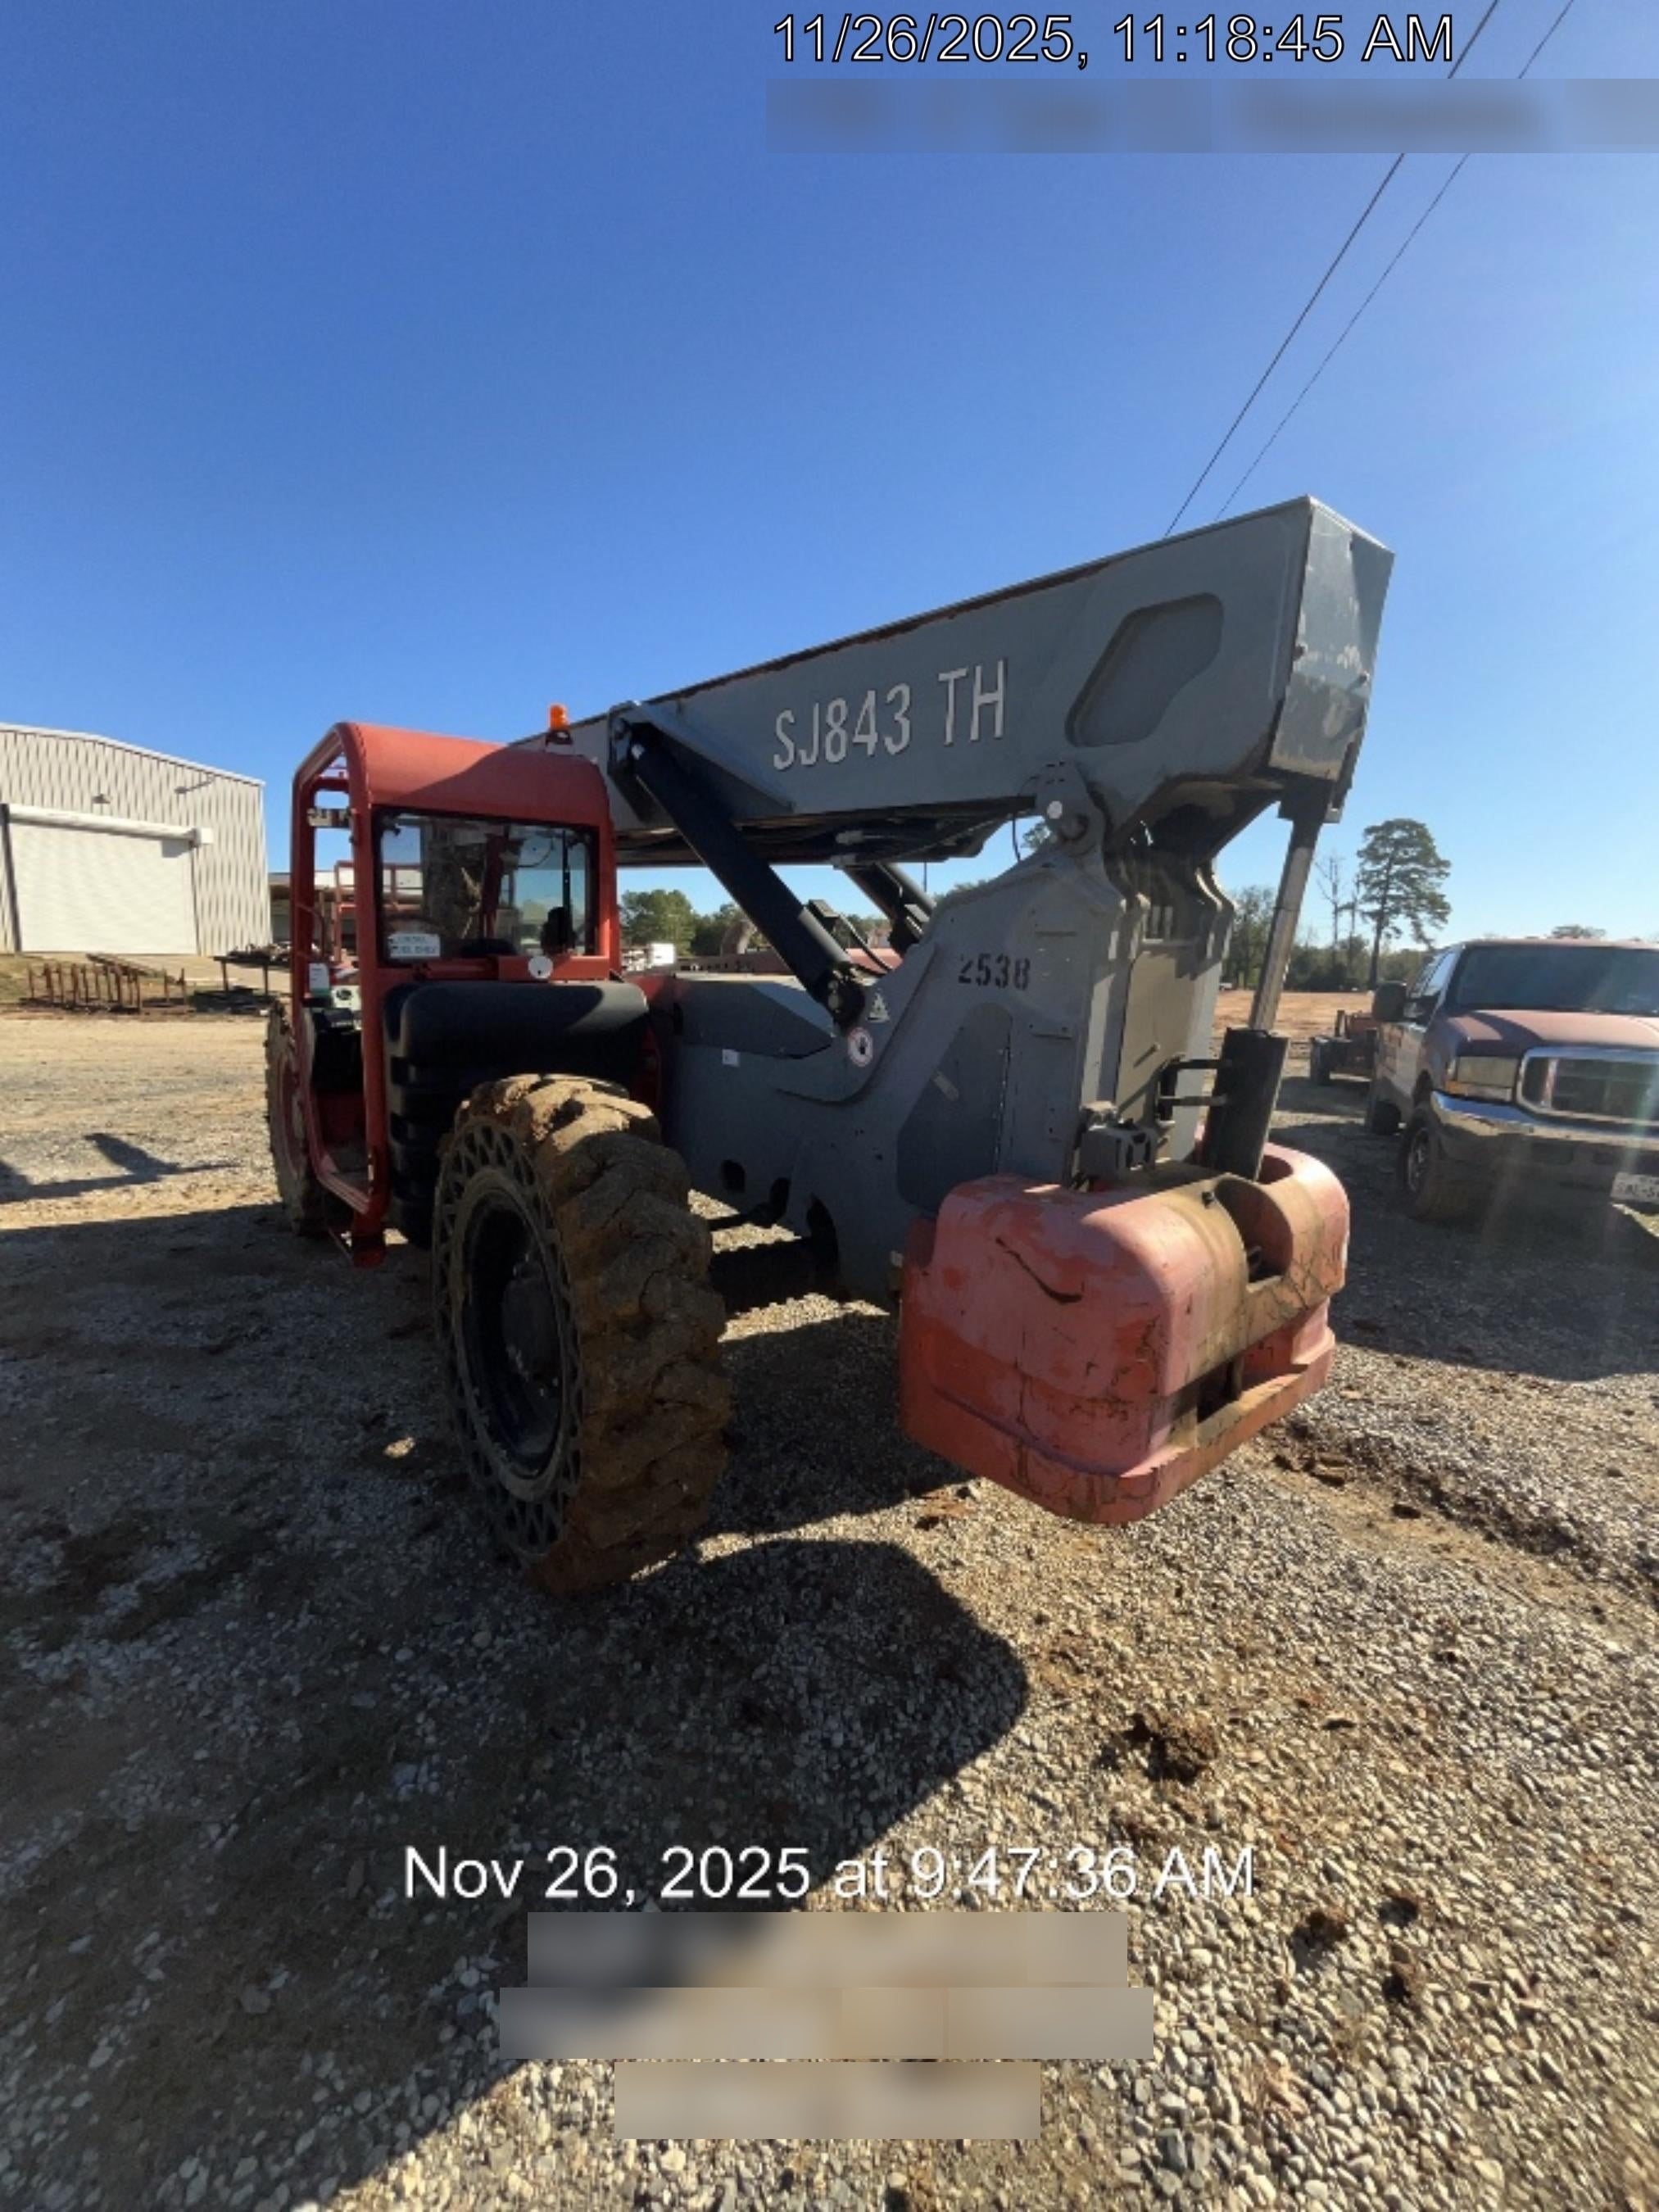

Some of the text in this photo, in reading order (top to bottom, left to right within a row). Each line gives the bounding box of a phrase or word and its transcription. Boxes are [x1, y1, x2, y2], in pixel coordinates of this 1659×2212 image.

[773, 659, 1004, 770] SJ843 TH
[959, 953, 1031, 990] 2538
